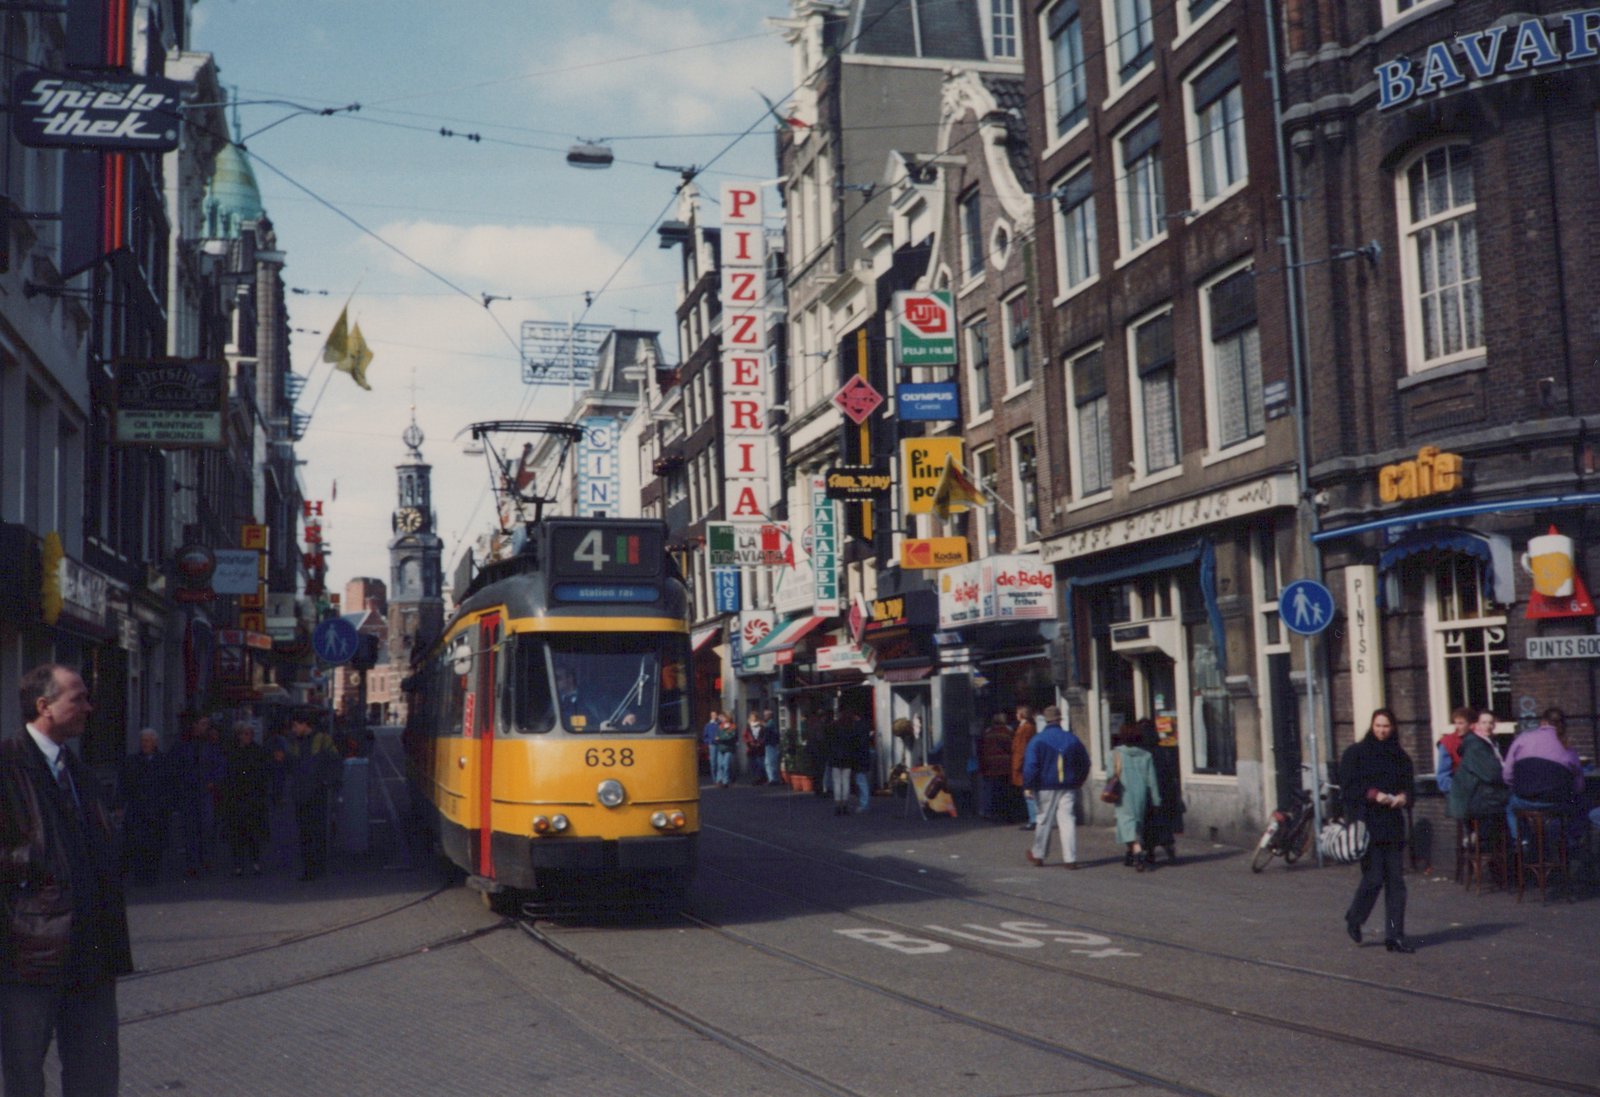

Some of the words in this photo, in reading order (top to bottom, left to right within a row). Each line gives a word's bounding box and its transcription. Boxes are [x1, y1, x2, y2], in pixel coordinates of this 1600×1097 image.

[1374, 7, 1600, 111] BAVAR
[32, 109, 162, 140] thek
[728, 189, 763, 516] PIZZERIA
[903, 346, 929, 356] FUJI
[902, 391, 953, 402] OLYMPUS
[152, 420, 204, 430] PAINTINGS
[155, 431, 204, 440] BRONZES
[573, 529, 610, 571] 4
[739, 536, 757, 549] LA
[814, 493, 831, 598] FALAFEL
[713, 550, 785, 562] TRAVIATA
[933, 551, 963, 562] Kodak
[1354, 579, 1367, 654] PINTS
[1528, 639, 1573, 657] PINTS
[584, 747, 635, 767] 638
[831, 920, 1112, 955] BUS
